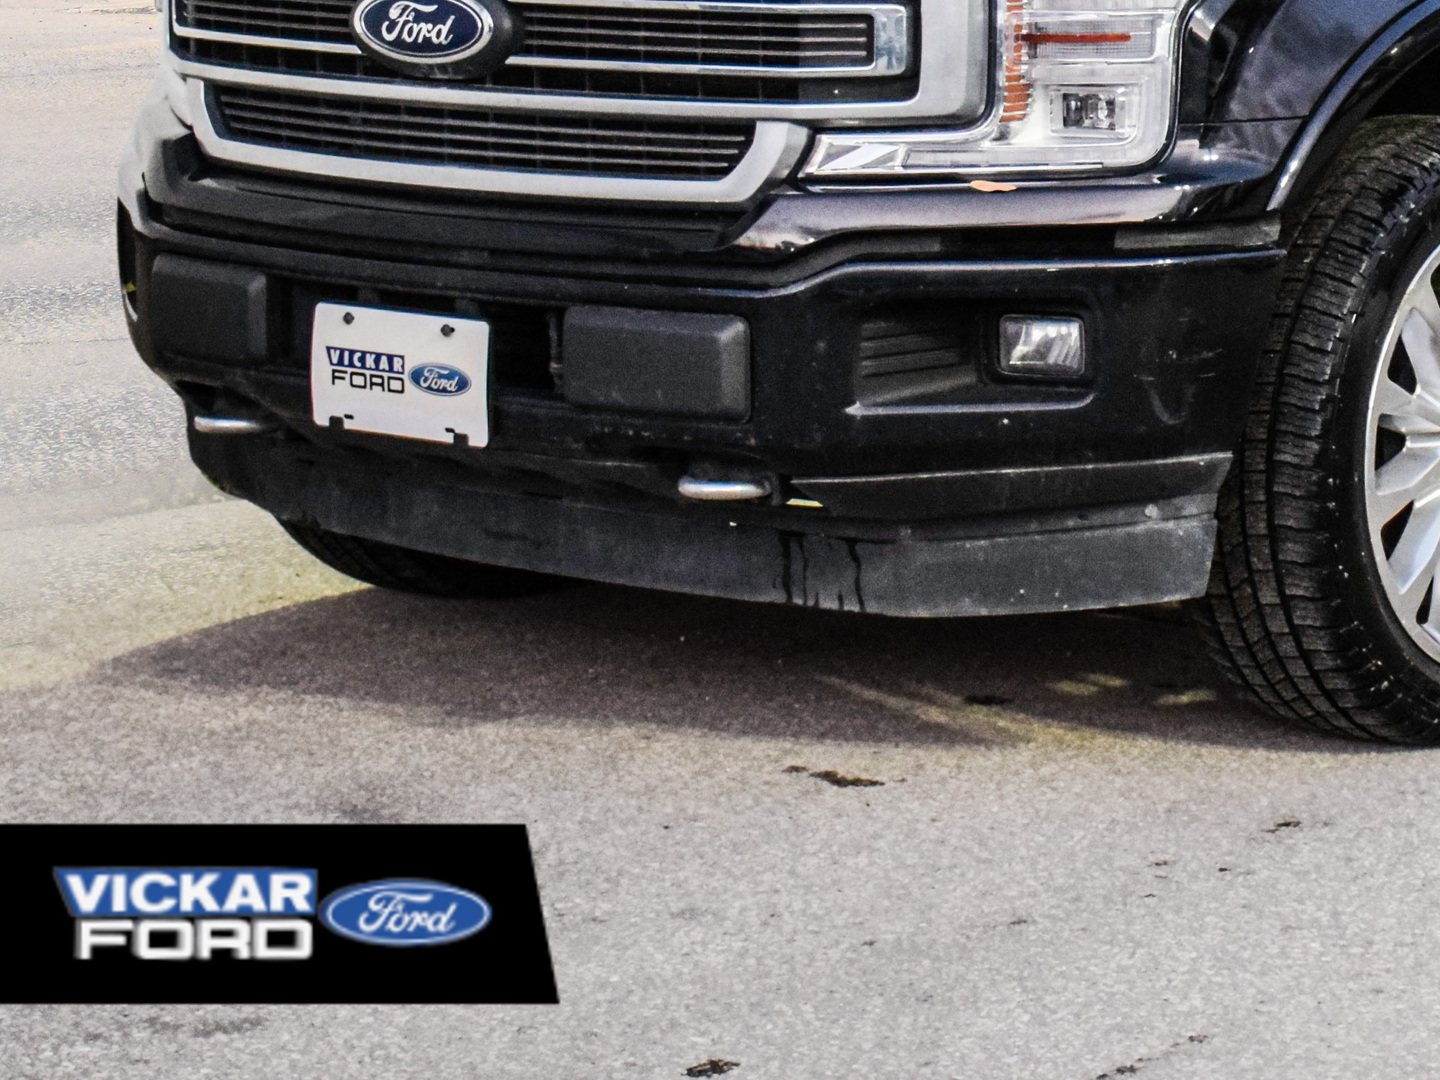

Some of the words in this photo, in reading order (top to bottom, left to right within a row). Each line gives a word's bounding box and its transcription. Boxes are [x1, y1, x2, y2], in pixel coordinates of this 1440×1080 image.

[381, 1, 454, 46] Ford
[329, 348, 404, 373] VICKAR
[331, 369, 405, 394] FORD
[419, 367, 459, 392] Ford
